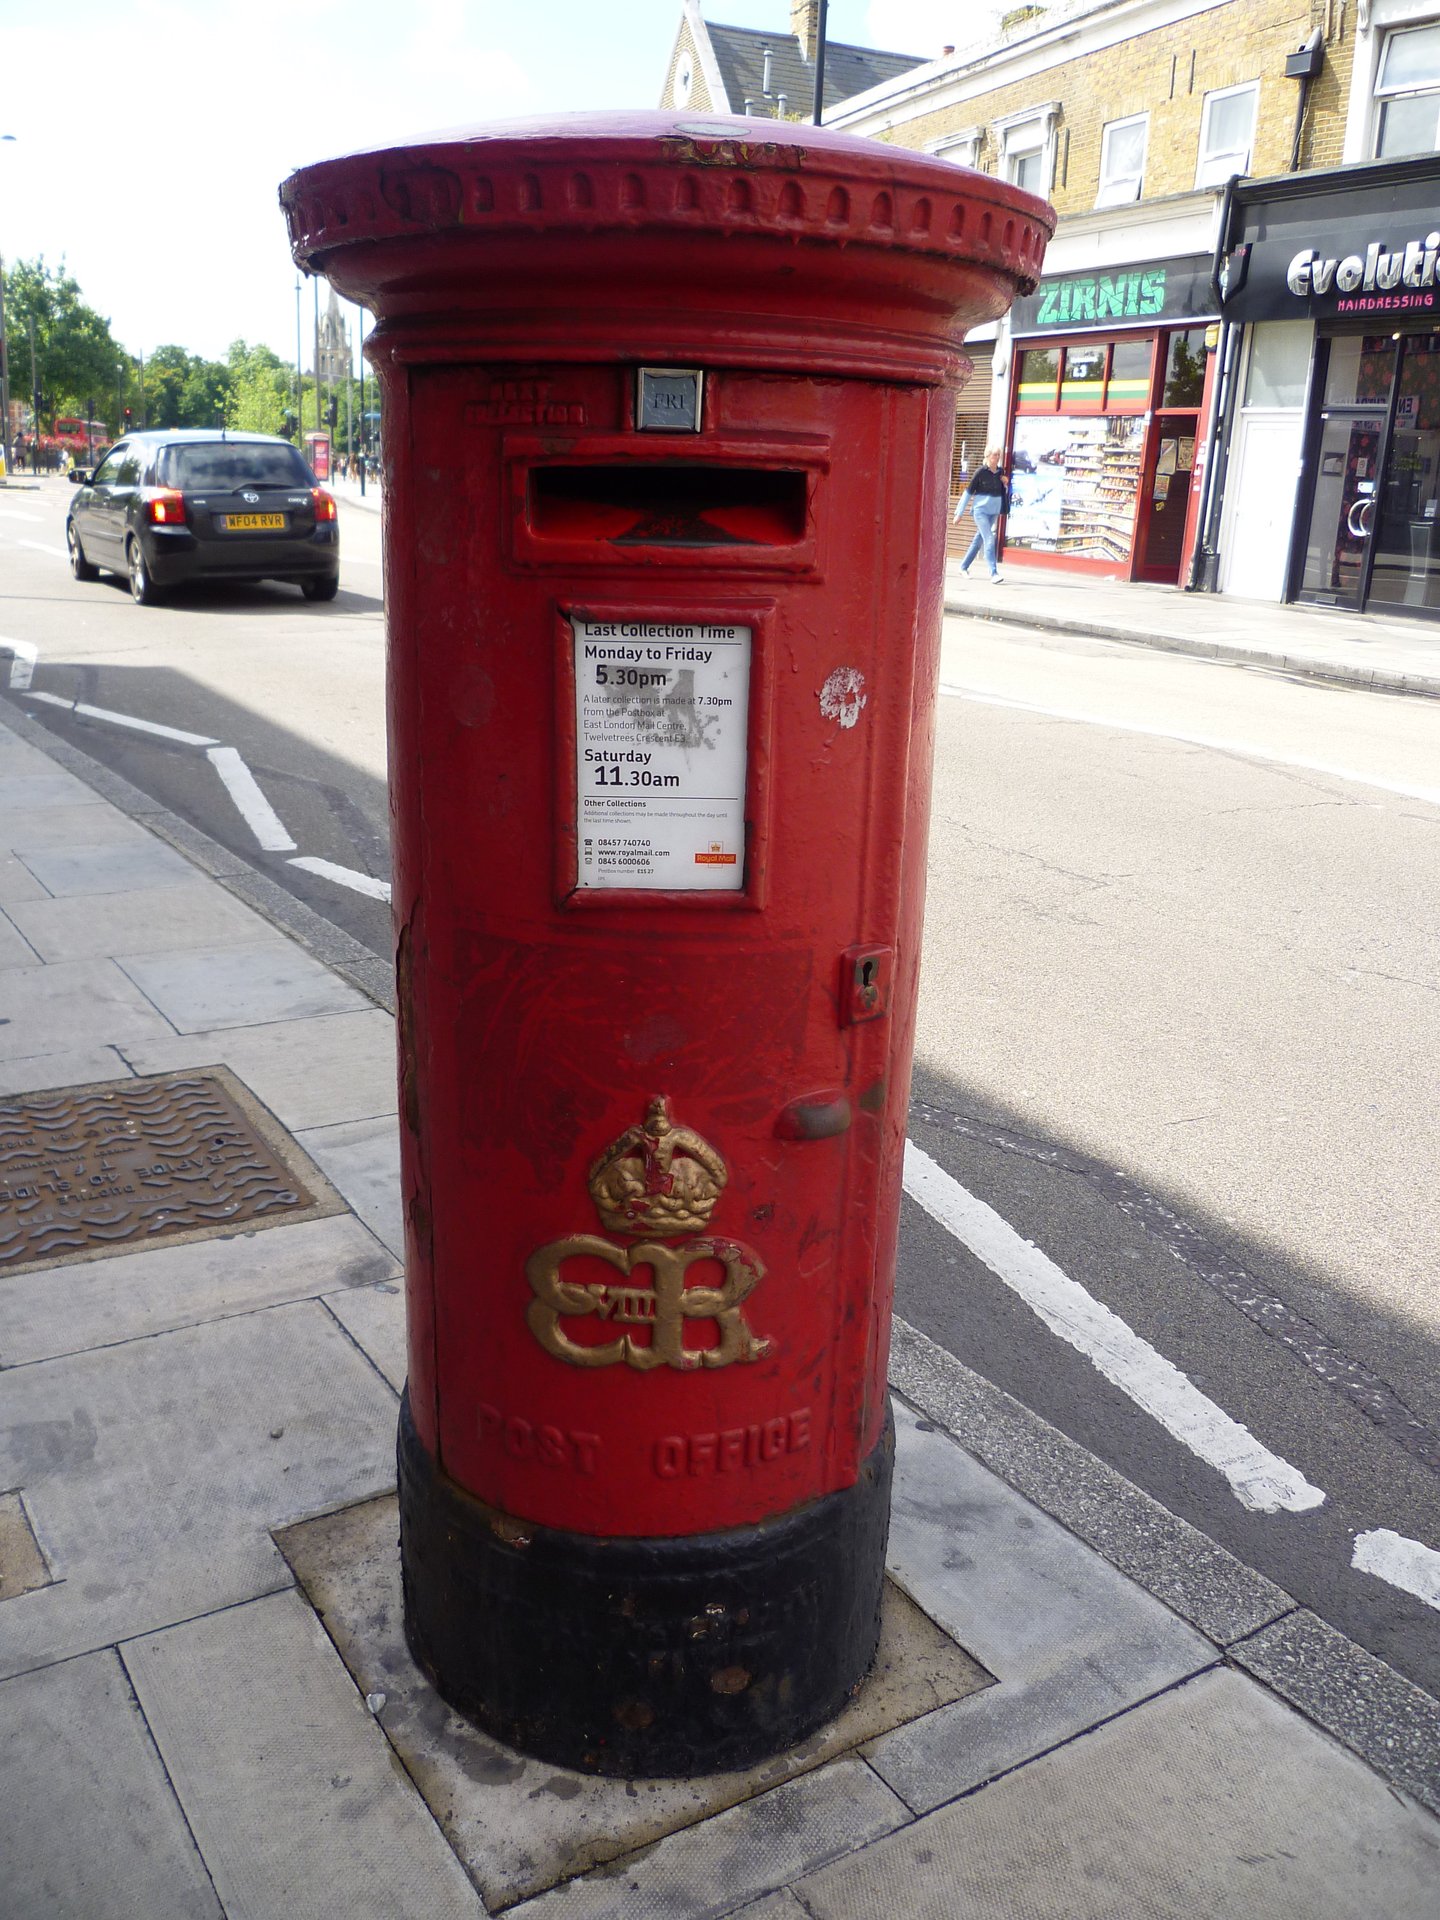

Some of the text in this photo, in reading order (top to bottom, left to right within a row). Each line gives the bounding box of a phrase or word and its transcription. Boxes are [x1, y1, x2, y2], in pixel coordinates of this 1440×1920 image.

[1287, 231, 1440, 296] Evoluti
[1037, 268, 1166, 324] ZIRNIS
[1337, 293, 1434, 312] HAIRDRESSING
[654, 393, 684, 410] FRI
[229, 514, 282, 527] WF04 RVR
[585, 623, 735, 639] Last Collection Time
[585, 646, 712, 663] Monday to Friday
[595, 664, 667, 688] 5.30pm
[583, 695, 732, 707] A later collection is made at 7.30pm
[583, 707, 665, 718] from the Postbox at
[583, 720, 602, 730] East
[604, 720, 635, 731] London
[637, 721, 655, 731] Mail
[584, 733, 634, 743] Twelvetrees
[636, 733, 673, 744] Crescent
[585, 749, 652, 765] Saturday
[594, 765, 680, 788] 11.30am
[584, 800, 647, 808] Other Collections
[669, 812, 697, 820] throughout
[623, 839, 651, 847] 740740
[598, 849, 670, 857] www.royalmail.com
[696, 855, 735, 864] Royal Mail
[618, 858, 651, 866] 6000606
[134, 1155, 226, 1178] RAPIDE
[57, 1184, 135, 1205] DUCTILE
[479, 1403, 811, 1479] POST OFFICE
